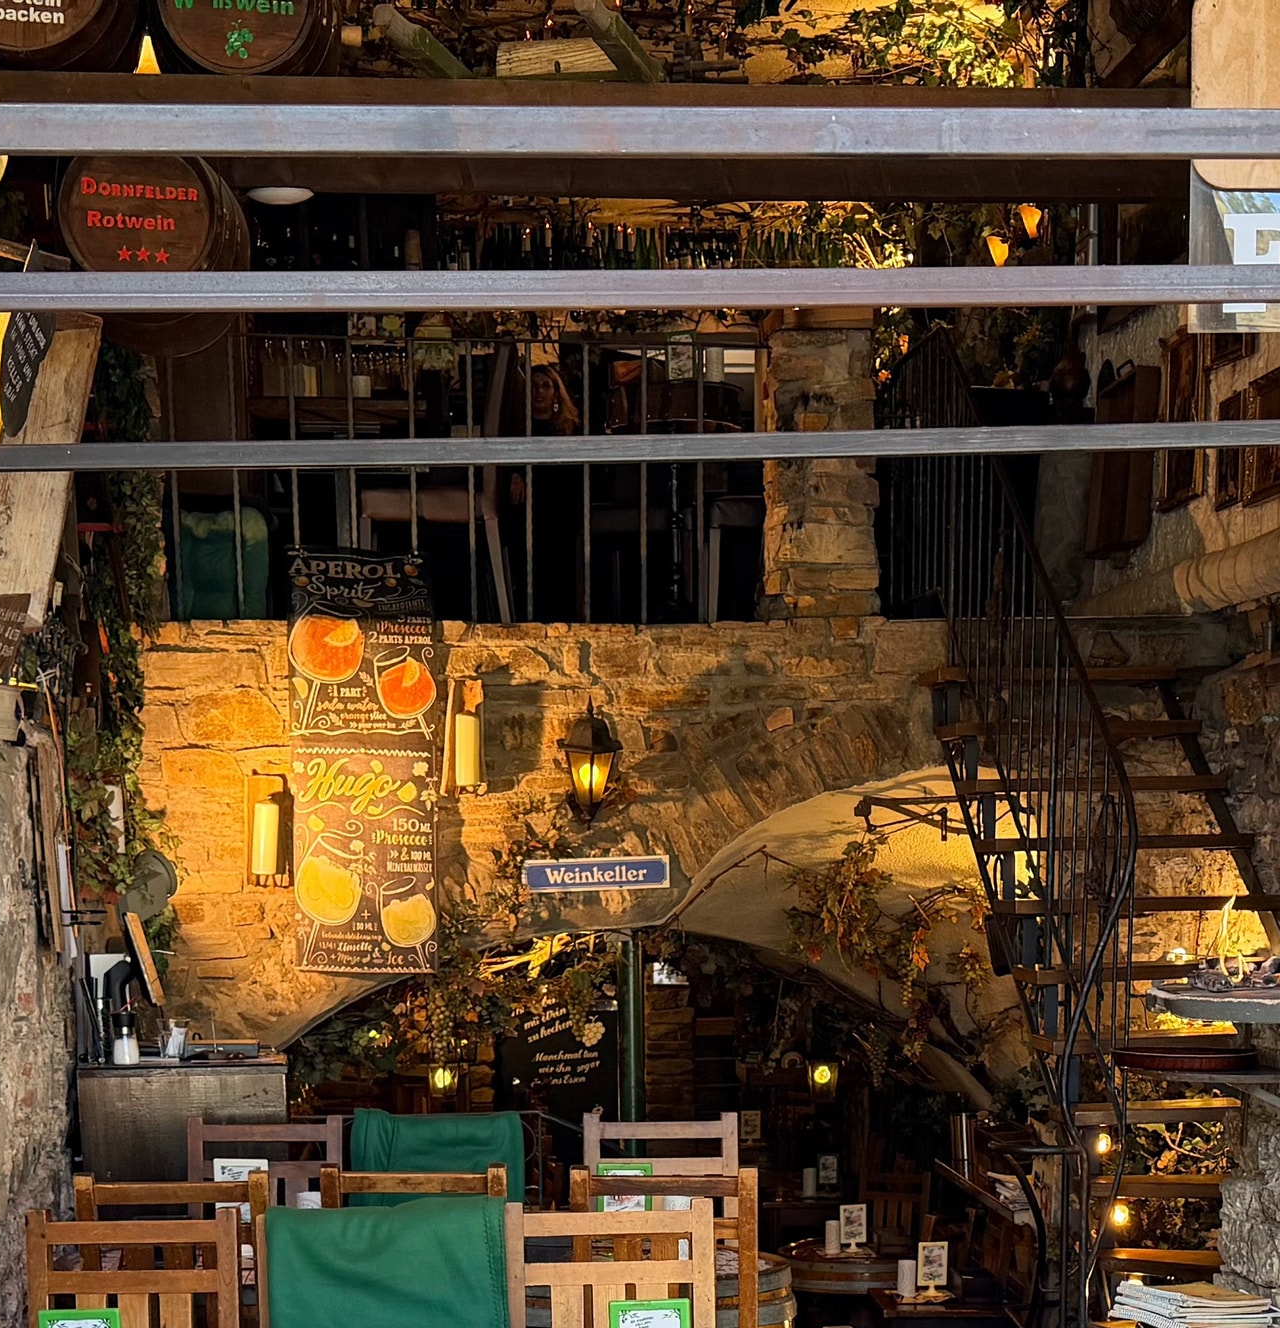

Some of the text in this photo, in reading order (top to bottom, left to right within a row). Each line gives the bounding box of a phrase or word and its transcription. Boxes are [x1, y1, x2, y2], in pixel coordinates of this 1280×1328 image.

[80, 176, 198, 201] DORNFELDER
[86, 210, 176, 231] Rotwein
[288, 557, 401, 579] APEROL
[307, 575, 382, 601] Spritz
[369, 631, 433, 645] 2 PARTS APEROL
[340, 687, 363, 698] PART
[348, 698, 380, 711] water
[299, 758, 400, 815] Hugo
[393, 818, 419, 832] 150
[400, 847, 410, 861] &
[410, 854, 422, 862] 100
[545, 866, 648, 885] Weinkeller
[532, 1050, 599, 1062] Manchmal tun
[538, 1064, 555, 1074] wir
[556, 1062, 572, 1073] ihn
